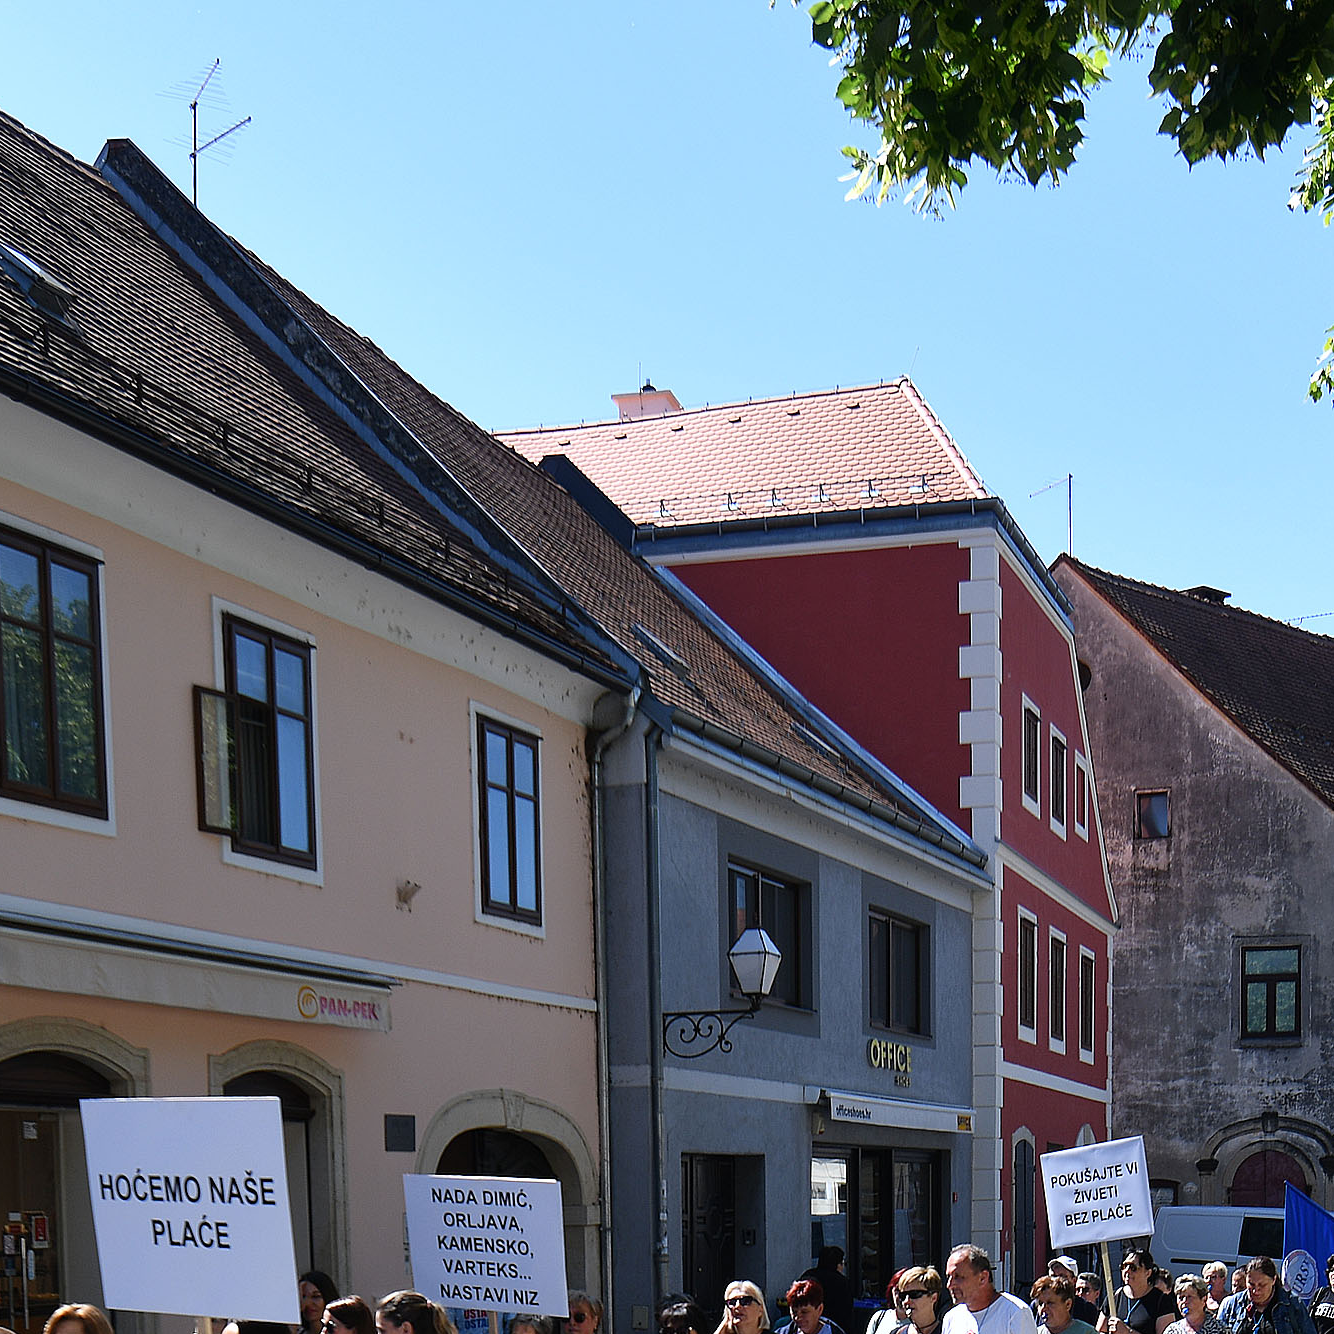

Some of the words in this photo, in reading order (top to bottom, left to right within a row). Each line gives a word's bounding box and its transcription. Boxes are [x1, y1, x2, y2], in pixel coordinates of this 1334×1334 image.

[319, 996, 379, 1020] PAN-PEK
[870, 1038, 912, 1072] OFFICE
[98, 1167, 202, 1203] HOĆEMO
[208, 1169, 276, 1206] NAŠE
[1050, 1164, 1123, 1188] POKUŠAJTE
[1125, 1161, 1138, 1175] VI
[431, 1187, 478, 1205] NADA
[482, 1189, 533, 1210] DIMIĆ,
[1074, 1185, 1118, 1204] ŽIVJETI
[443, 1212, 524, 1234] ORLJAVA,
[1065, 1211, 1089, 1227] BEZ
[1091, 1203, 1133, 1222] PLAĆE
[151, 1214, 231, 1249] PLAĆE
[437, 1235, 534, 1259] KAMENSKO,
[442, 1258, 532, 1280] VARTEKS...
[440, 1283, 509, 1304] NASTAVI
[513, 1289, 540, 1306] NIZ
